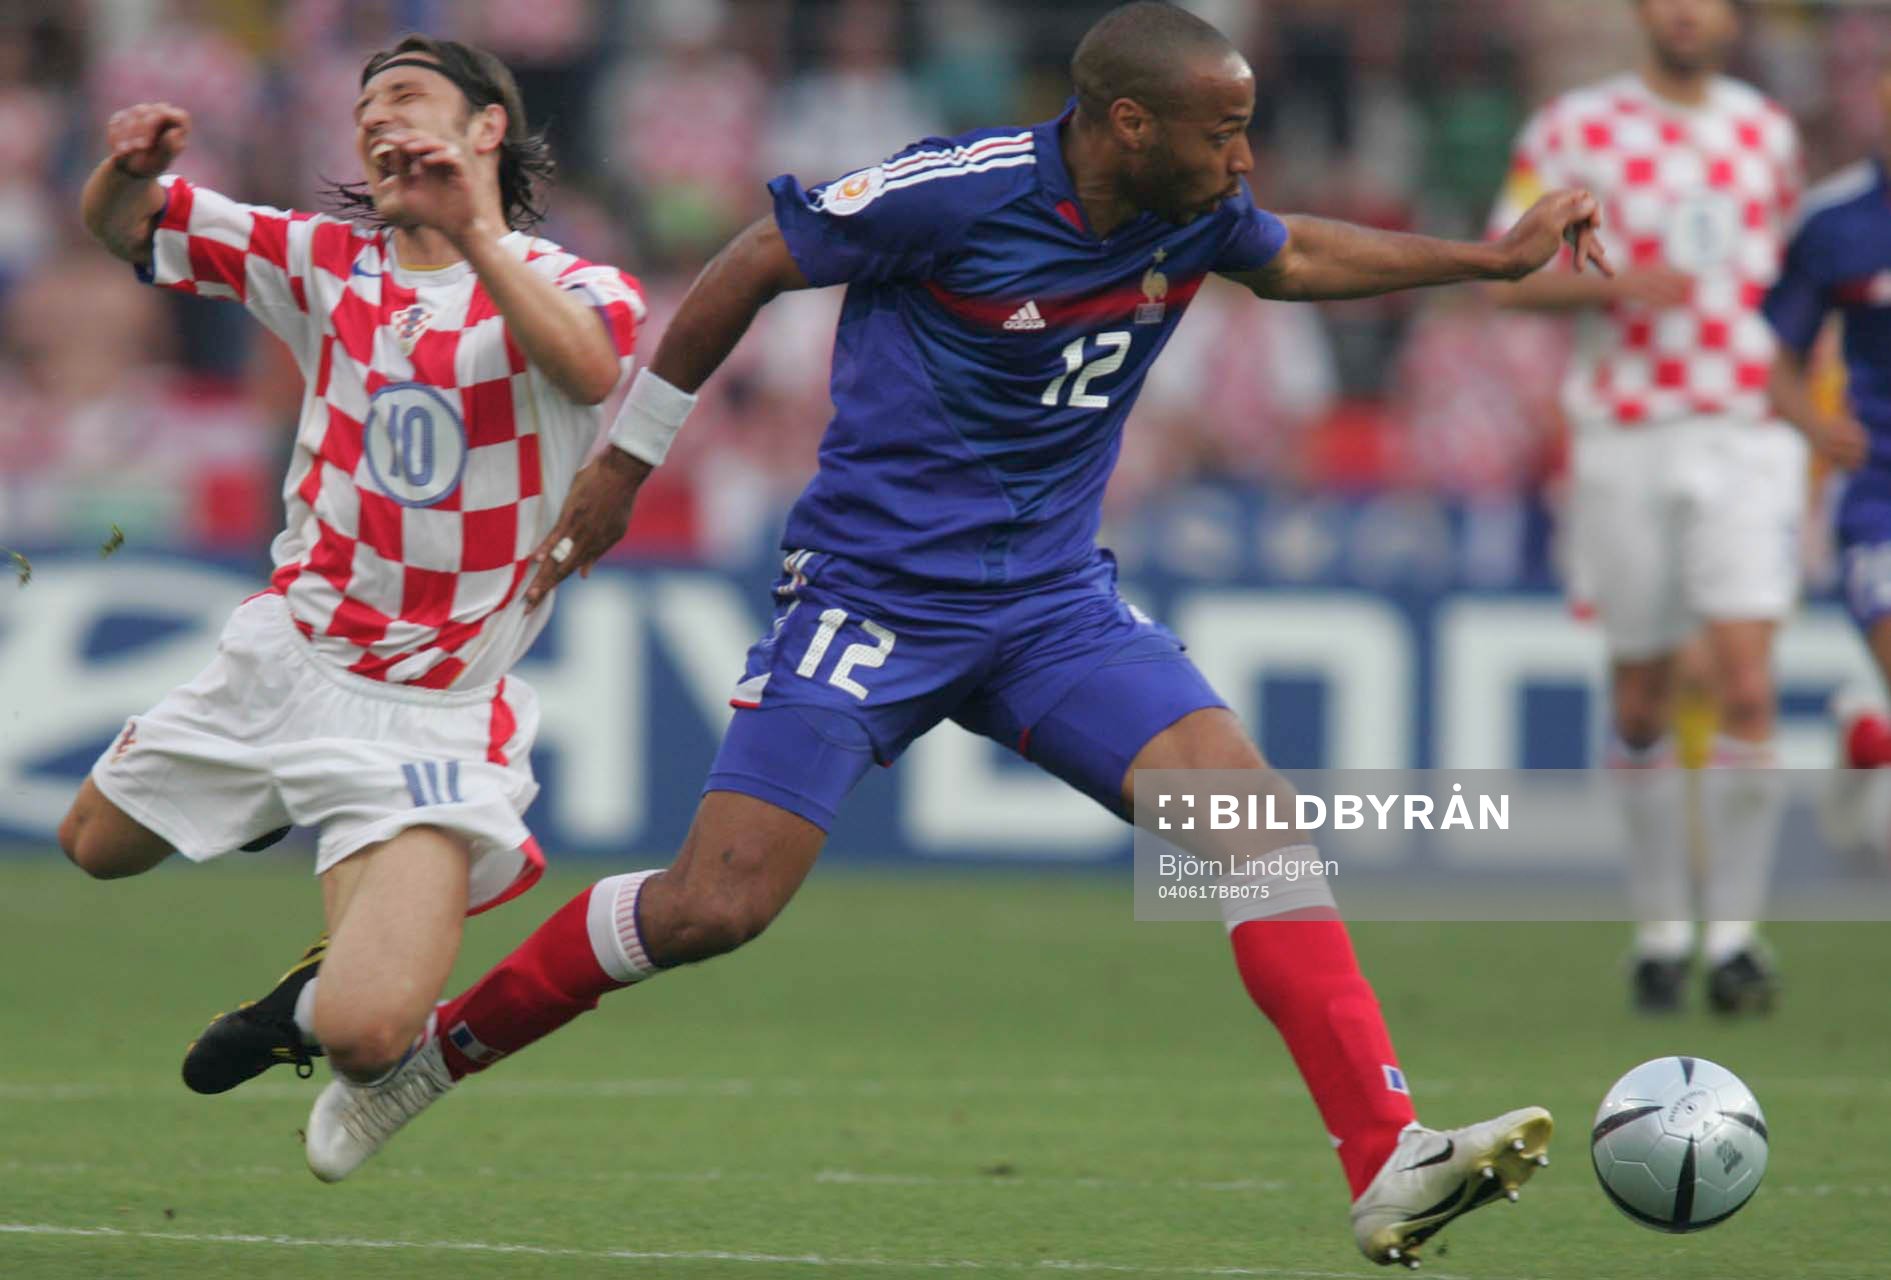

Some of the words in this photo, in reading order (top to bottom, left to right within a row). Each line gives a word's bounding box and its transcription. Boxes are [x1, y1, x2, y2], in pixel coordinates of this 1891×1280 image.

[1041, 331, 1132, 408] 12
[387, 403, 435, 487] 10
[796, 608, 897, 701] 12
